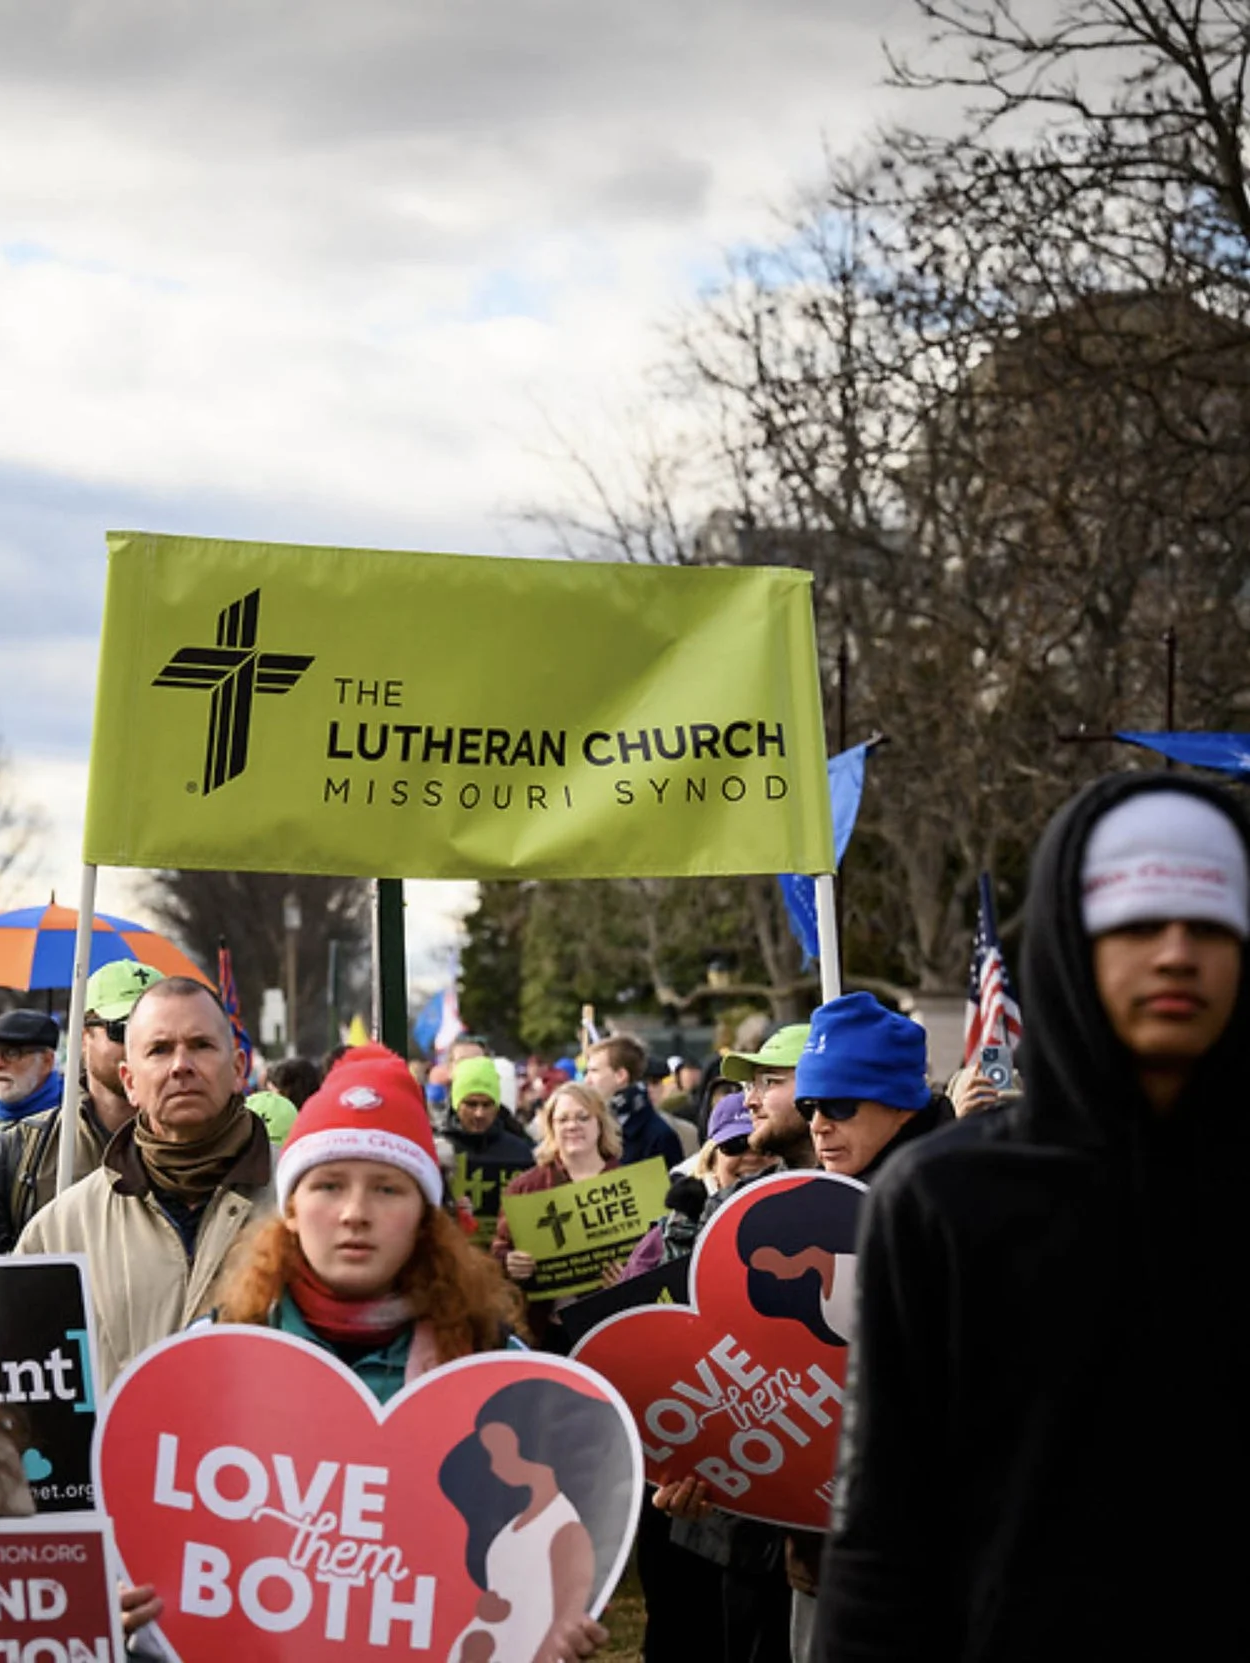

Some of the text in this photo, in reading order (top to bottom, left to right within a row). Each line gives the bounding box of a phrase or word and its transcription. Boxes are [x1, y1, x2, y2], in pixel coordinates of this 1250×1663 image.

[334, 677, 403, 707] THE
[327, 720, 786, 767] LUTHERAN CHURCH
[324, 775, 788, 810] MISSOURI SYNOD
[574, 1179, 632, 1209] LCMS
[580, 1197, 639, 1230] LIFE
[698, 1367, 800, 1430] them
[695, 1363, 847, 1498] BOTH
[154, 1432, 389, 1540] LOVE
[252, 1511, 410, 1581] them
[180, 1541, 437, 1650] BOTH
